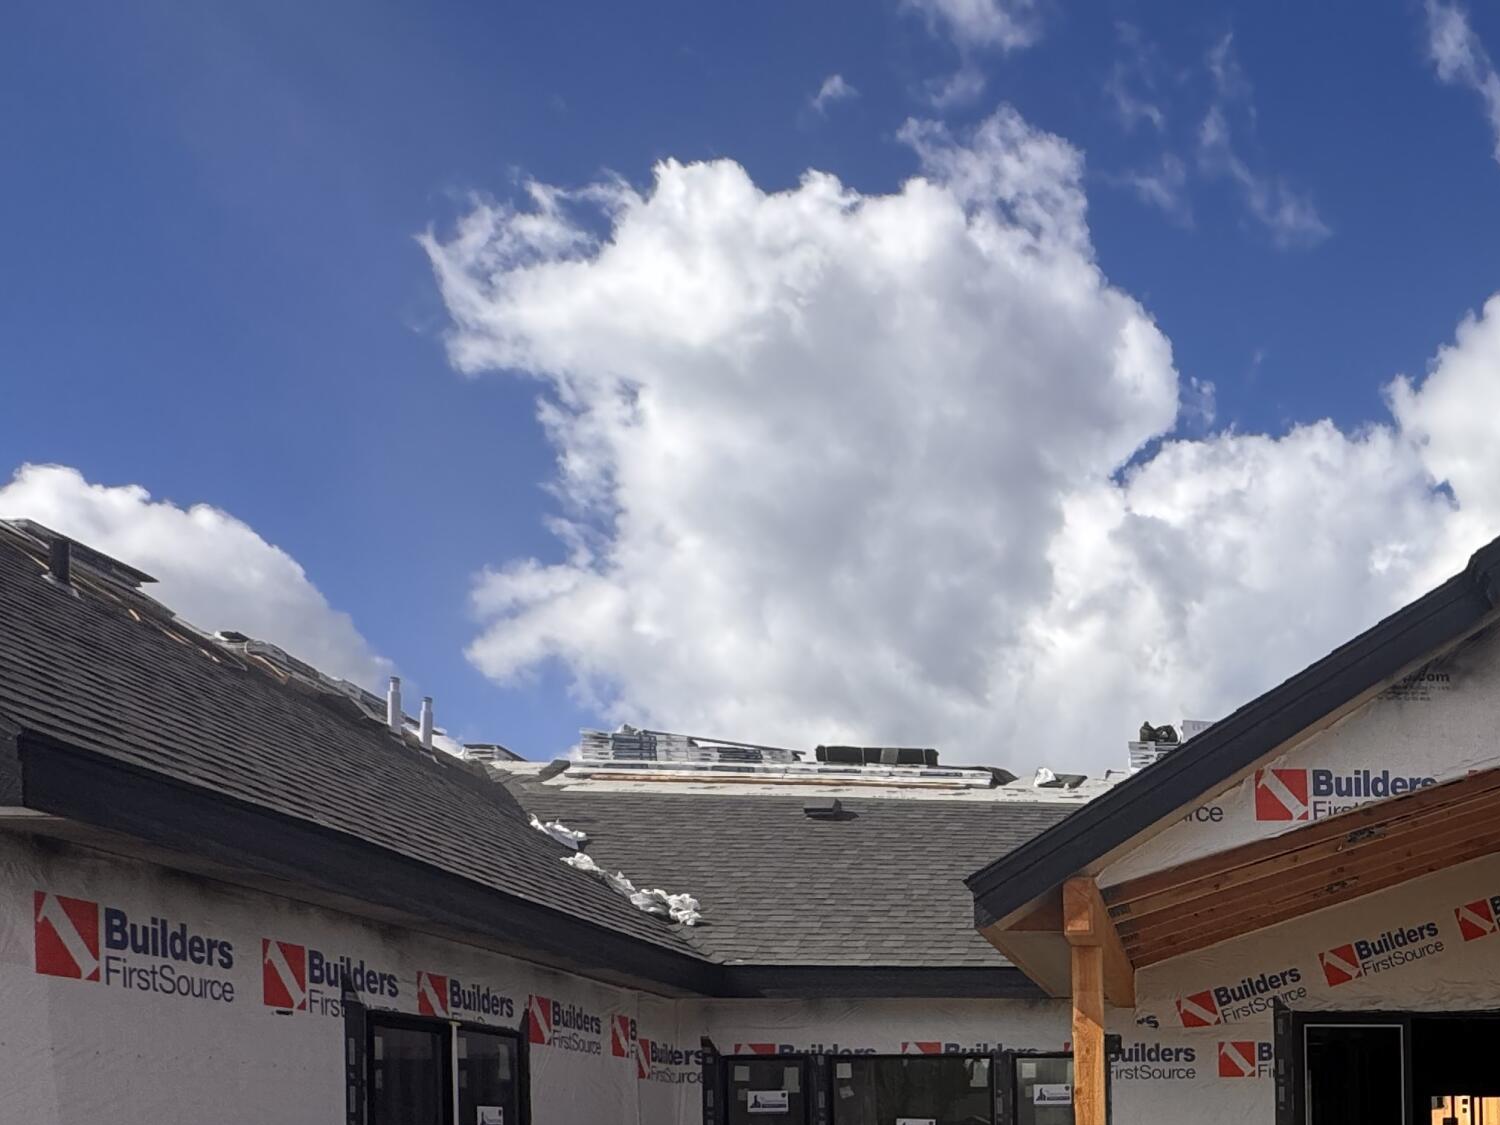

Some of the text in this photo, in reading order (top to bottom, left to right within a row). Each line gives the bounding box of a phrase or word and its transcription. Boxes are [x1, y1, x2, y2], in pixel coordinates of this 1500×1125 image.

[1312, 769, 1437, 797] Builders
[104, 907, 234, 969] Builders
[1355, 922, 1438, 960] Builders
[1361, 938, 1444, 976] FirstSource
[105, 956, 235, 1003] FirstSource
[308, 950, 399, 998] Builders
[1214, 968, 1301, 1007] Builders
[450, 979, 514, 1018] Builders
[552, 1001, 601, 1034] Builders
[552, 1032, 602, 1055] FirstSource
[651, 1041, 703, 1065] Builders
